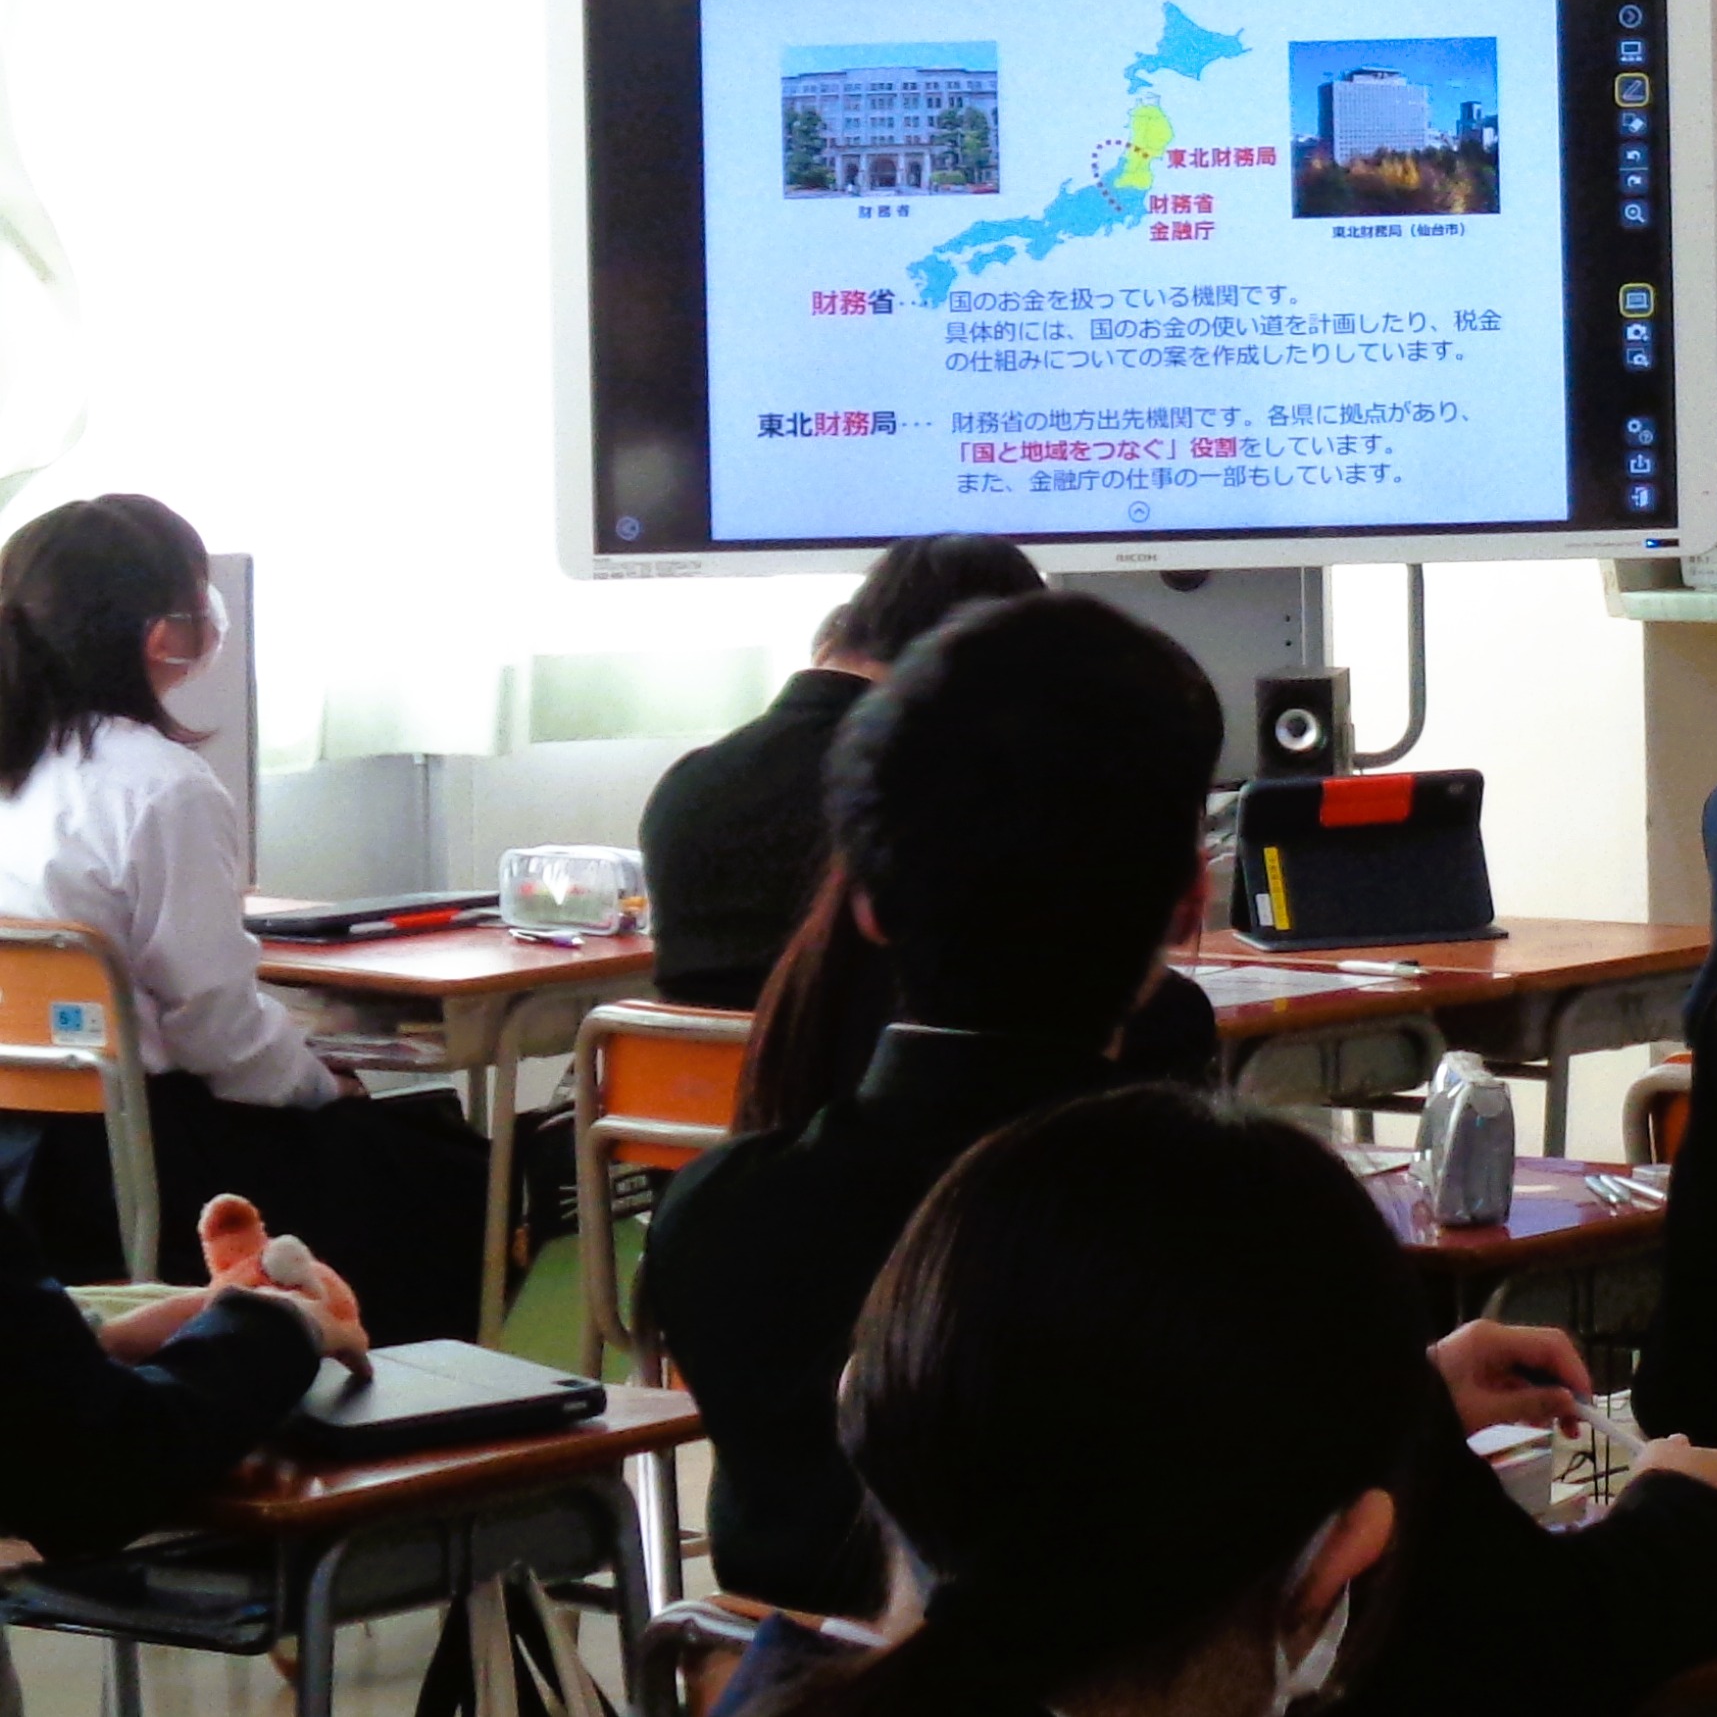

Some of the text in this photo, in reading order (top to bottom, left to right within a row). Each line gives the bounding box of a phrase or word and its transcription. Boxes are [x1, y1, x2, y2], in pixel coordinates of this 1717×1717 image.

[1167, 146, 1277, 169] 東北財務局
[1149, 194, 1214, 215] 財務省
[1149, 221, 1215, 242] 金融庁
[950, 285, 1299, 313] 国のお金を扱っている機関です。
[945, 309, 1502, 344] 具体的には、国のお金の使い道を計画したり、税金
[945, 340, 1465, 372] の仕組みについての案を作成したりしています。
[952, 401, 1470, 434] 財務省の地方出先機関です。各県に拠点があり、
[960, 434, 1394, 463] 「国と地域をつなぐ」役割をしています。
[957, 463, 1403, 494] また、金融庁の仕事の一部もしています。
